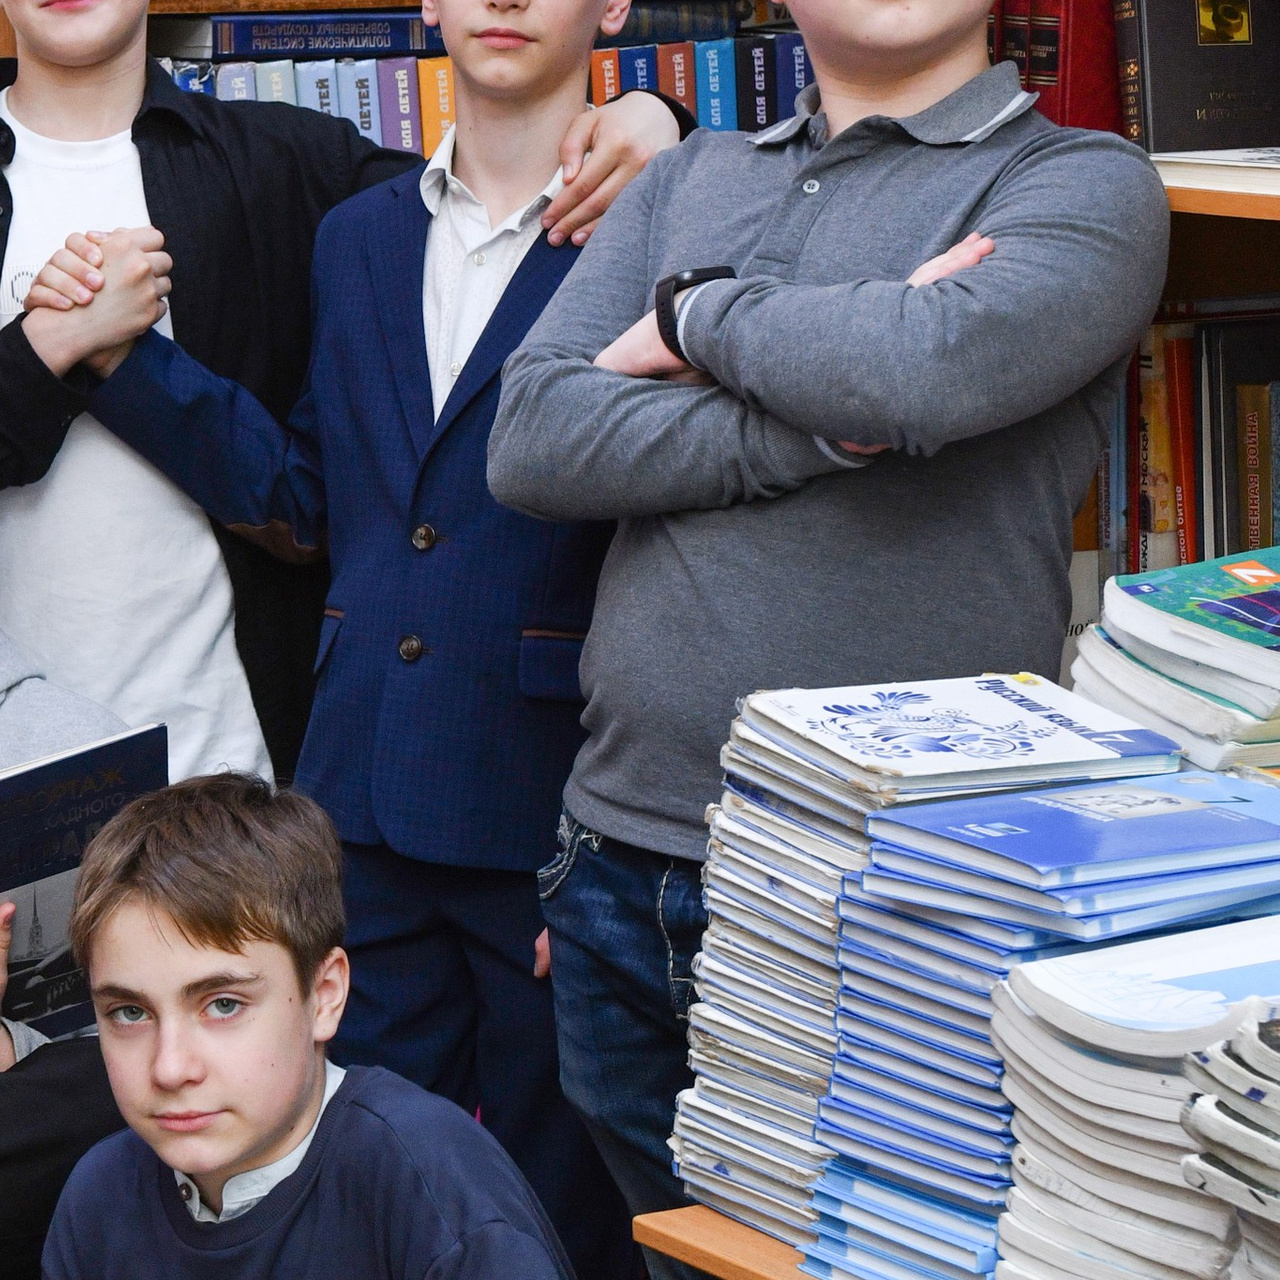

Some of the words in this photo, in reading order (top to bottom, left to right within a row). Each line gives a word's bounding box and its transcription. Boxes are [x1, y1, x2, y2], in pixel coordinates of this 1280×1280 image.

[252, 24, 315, 36] ГОСУДАРСТВ
[252, 37, 305, 50] СИСТЕМЫ
[308, 35, 391, 48] ПОЛИТИЧЕСКИЕ
[316, 22, 390, 34] СОВРЕМЕННЫХ
[672, 53, 685, 97] ДЕТЕЙ
[706, 49, 719, 93] ДЕТЕЙ
[752, 47, 765, 91] ДЕТЕЙ
[793, 45, 805, 89] ДЕТЕЙ
[355, 77, 372, 130] ДЕТЕЙ
[394, 69, 410, 114] ДЕТЕЙ
[436, 69, 450, 113] ДЕТЕЙ
[711, 98, 721, 126] ДЛЯ
[756, 96, 767, 124] ДЛЯ
[400, 119, 412, 148] ДЛЯ
[1245, 411, 1259, 468] ВОЙНА
[973, 678, 1054, 718] Русский
[1042, 711, 1101, 735] язык
[1090, 733, 1136, 743] 7
